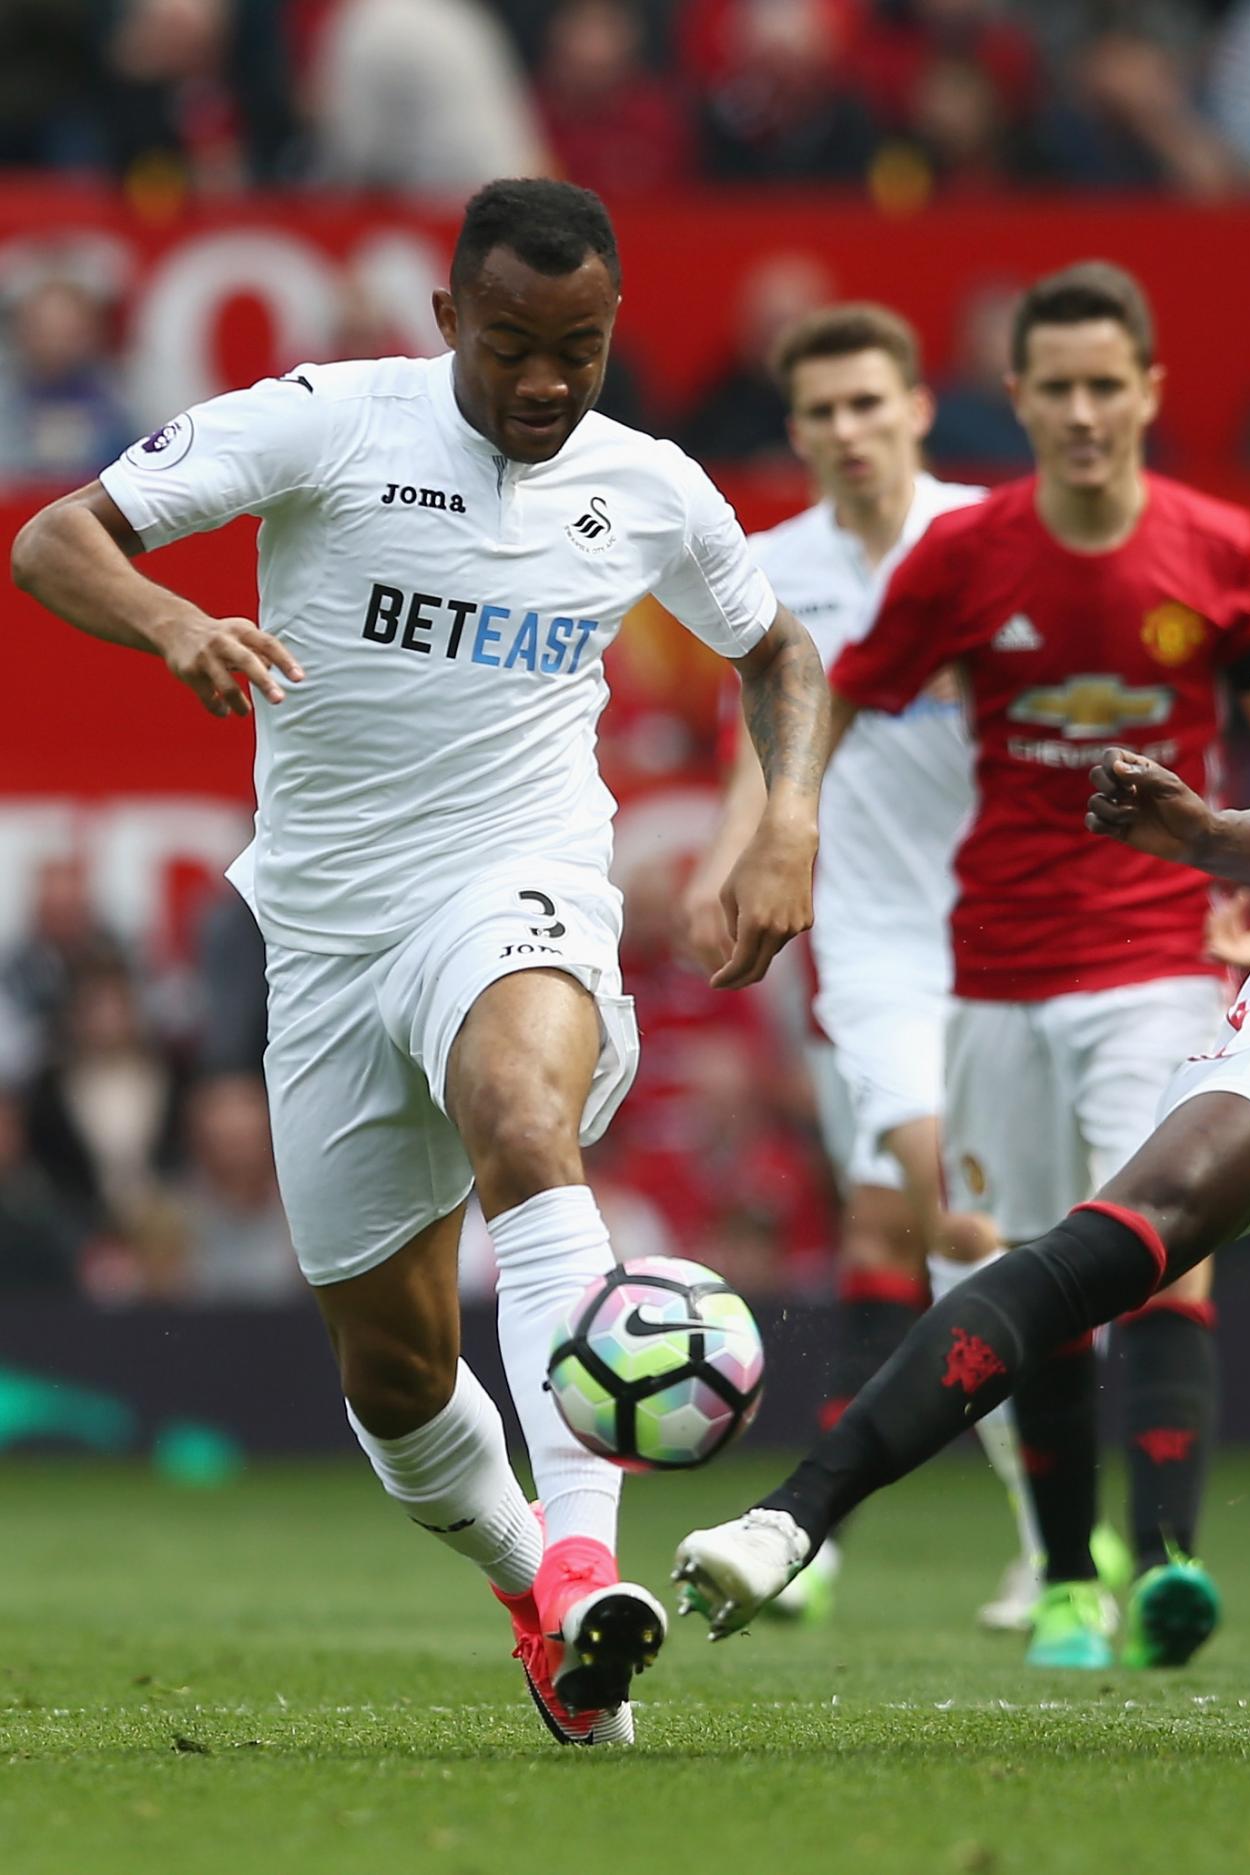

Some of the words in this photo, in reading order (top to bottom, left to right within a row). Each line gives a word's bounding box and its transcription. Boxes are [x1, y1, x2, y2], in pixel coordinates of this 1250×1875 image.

[381, 484, 466, 513] Joma
[362, 583, 599, 675] BETEAST
[518, 890, 566, 938] 3
[499, 944, 563, 959] Jom
